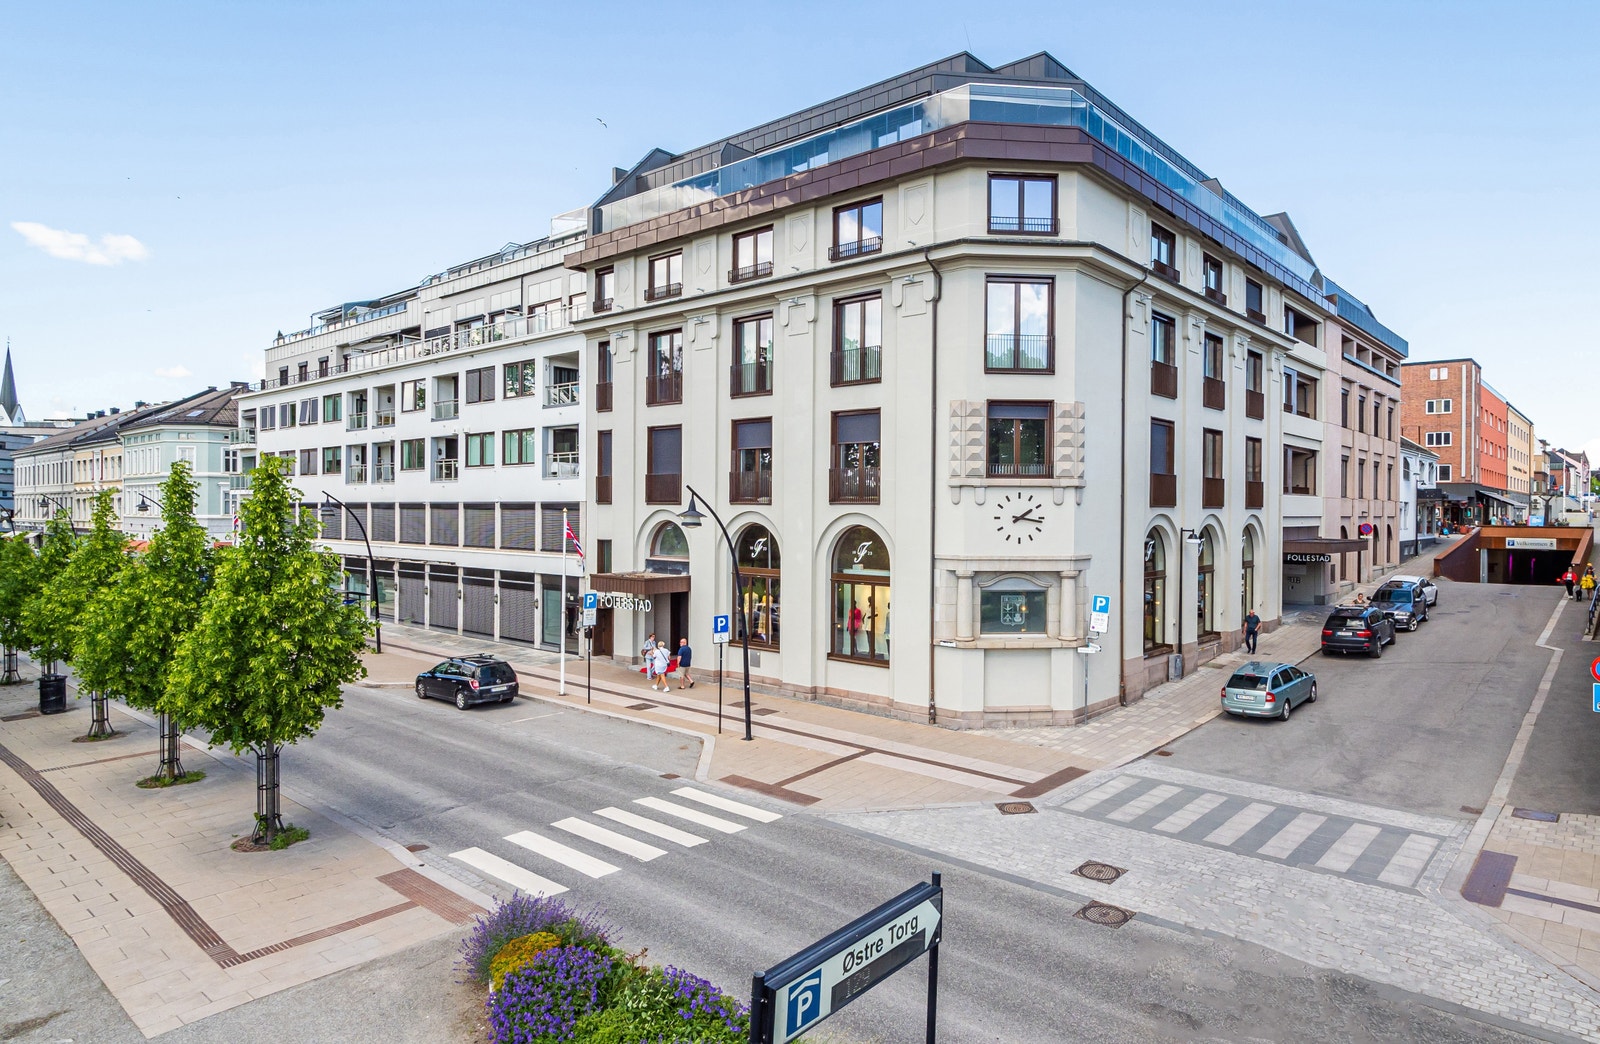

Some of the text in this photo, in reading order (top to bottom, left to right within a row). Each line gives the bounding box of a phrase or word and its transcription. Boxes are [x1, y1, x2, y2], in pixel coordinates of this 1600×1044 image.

[1287, 554, 1330, 562] FOLLESTAD
[586, 595, 595, 607] P
[1095, 597, 1107, 611] P
[717, 617, 726, 632] P
[842, 915, 919, 975] Østre Torg
[796, 990, 813, 1028] P
